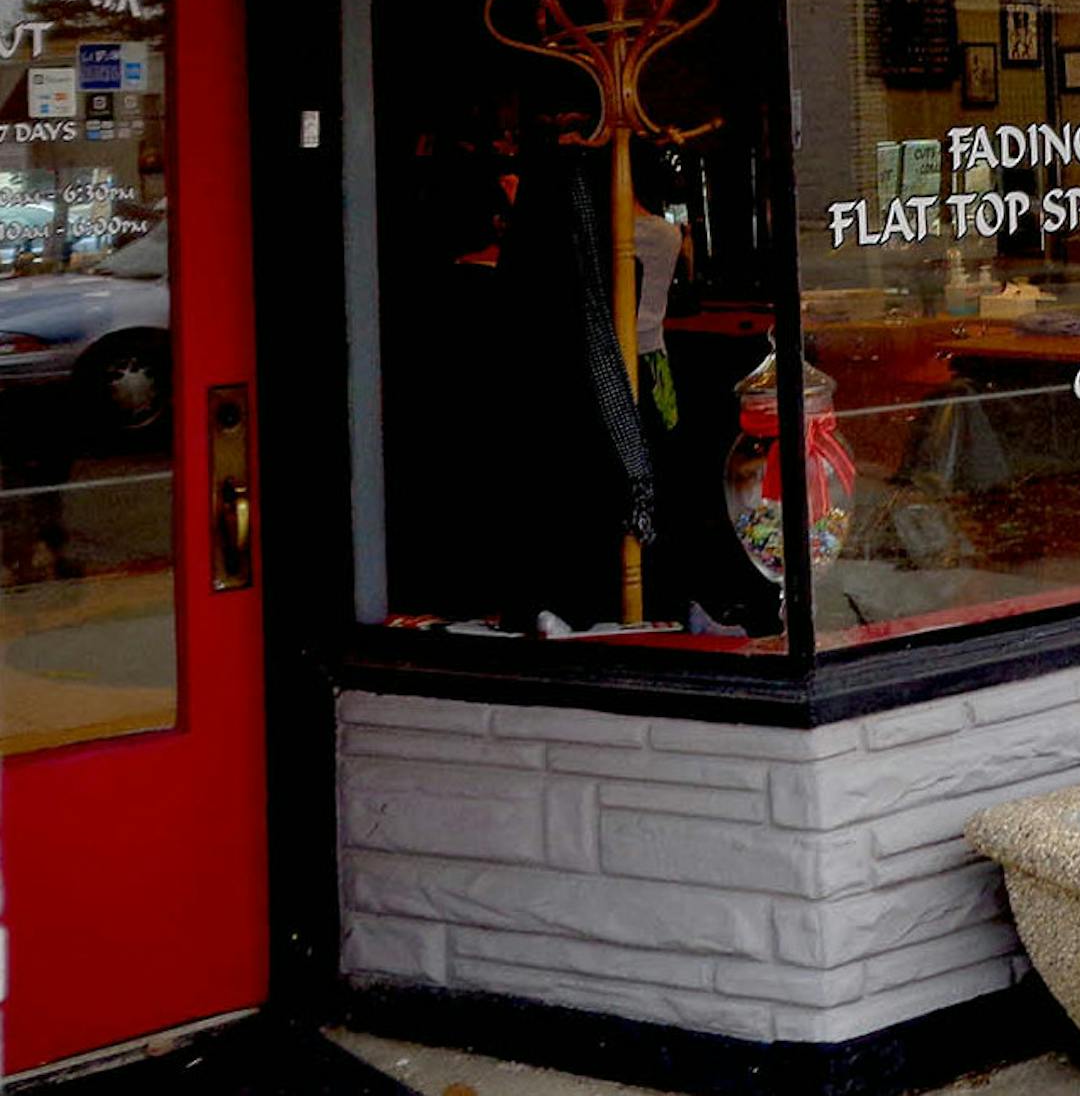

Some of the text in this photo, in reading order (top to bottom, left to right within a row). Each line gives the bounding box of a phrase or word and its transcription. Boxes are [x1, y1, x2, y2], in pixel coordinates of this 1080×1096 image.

[15, 121, 77, 142] DAYS
[828, 196, 939, 249] FLAT
[945, 190, 1030, 240] TOP
